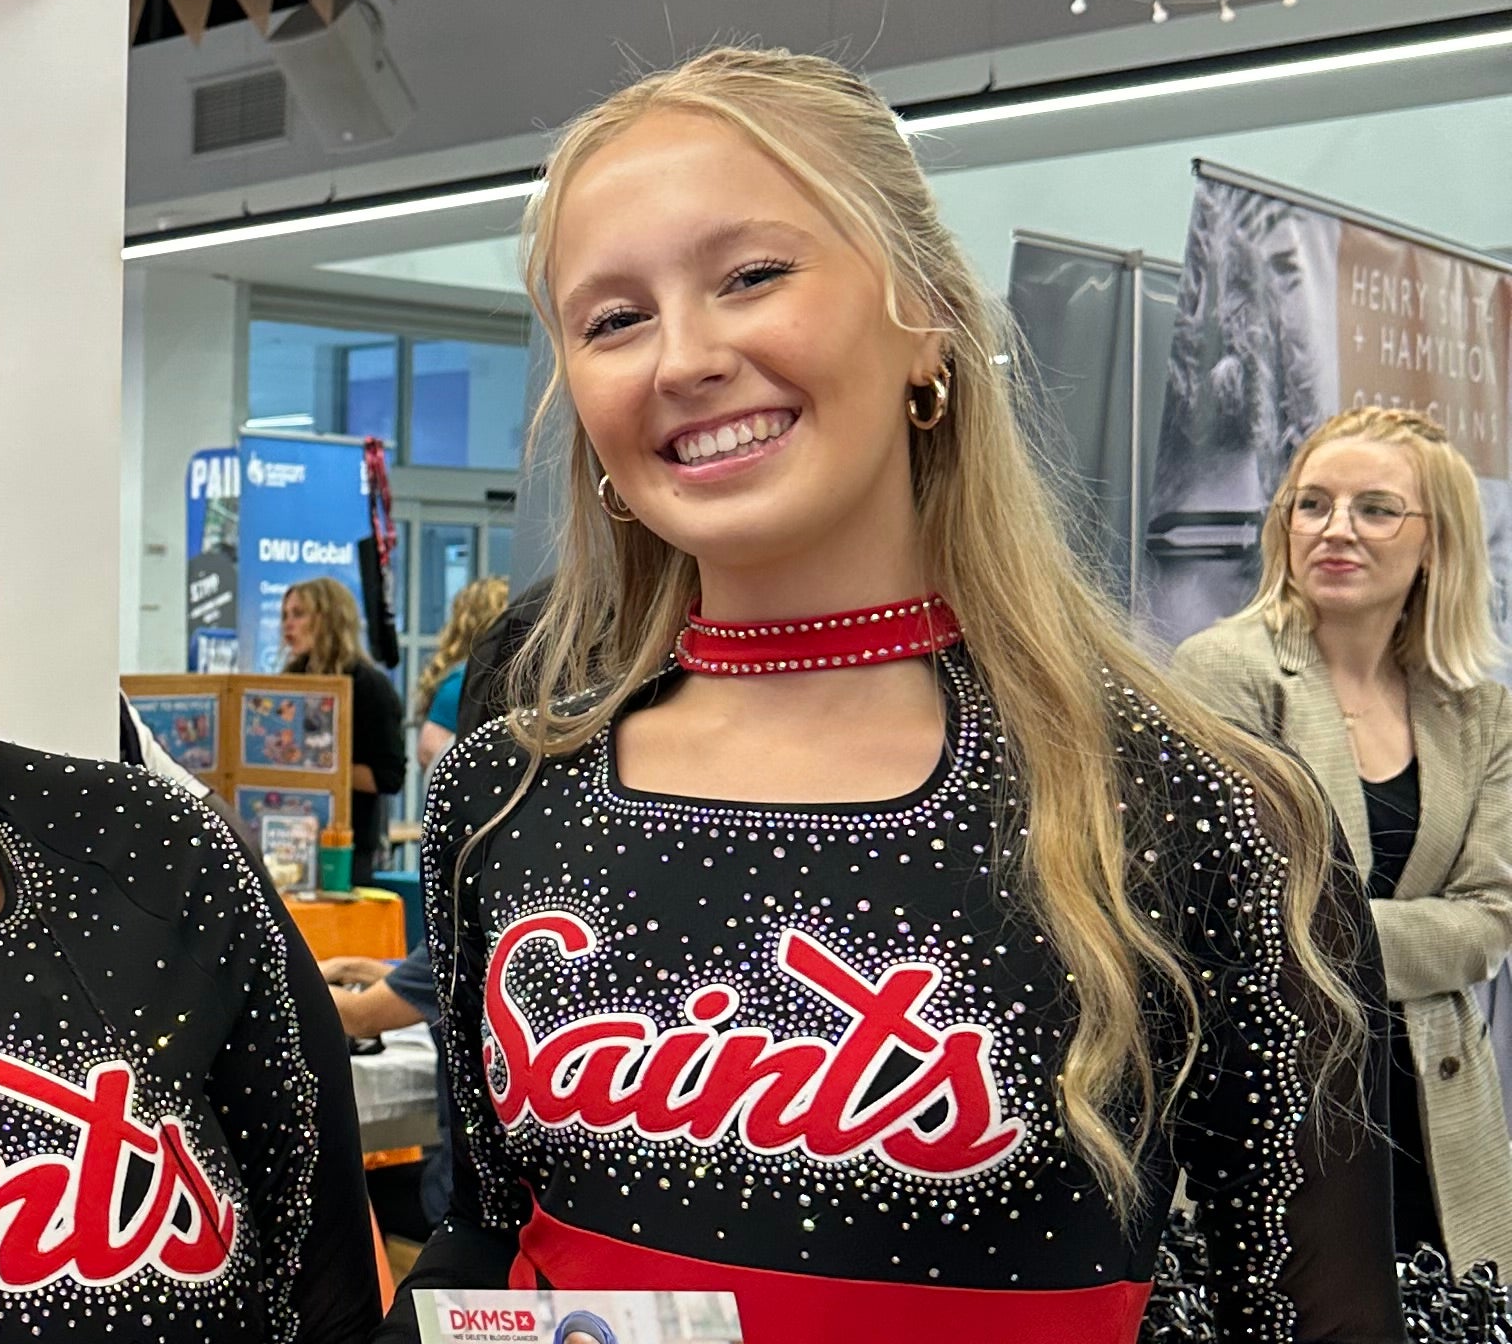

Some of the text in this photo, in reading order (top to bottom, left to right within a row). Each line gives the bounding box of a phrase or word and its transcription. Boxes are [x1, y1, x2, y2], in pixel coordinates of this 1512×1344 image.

[1352, 265, 1427, 320] HENRY
[259, 539, 353, 565] DMU Global
[484, 911, 1026, 1178] Saints
[450, 1310, 514, 1331] DKMS
